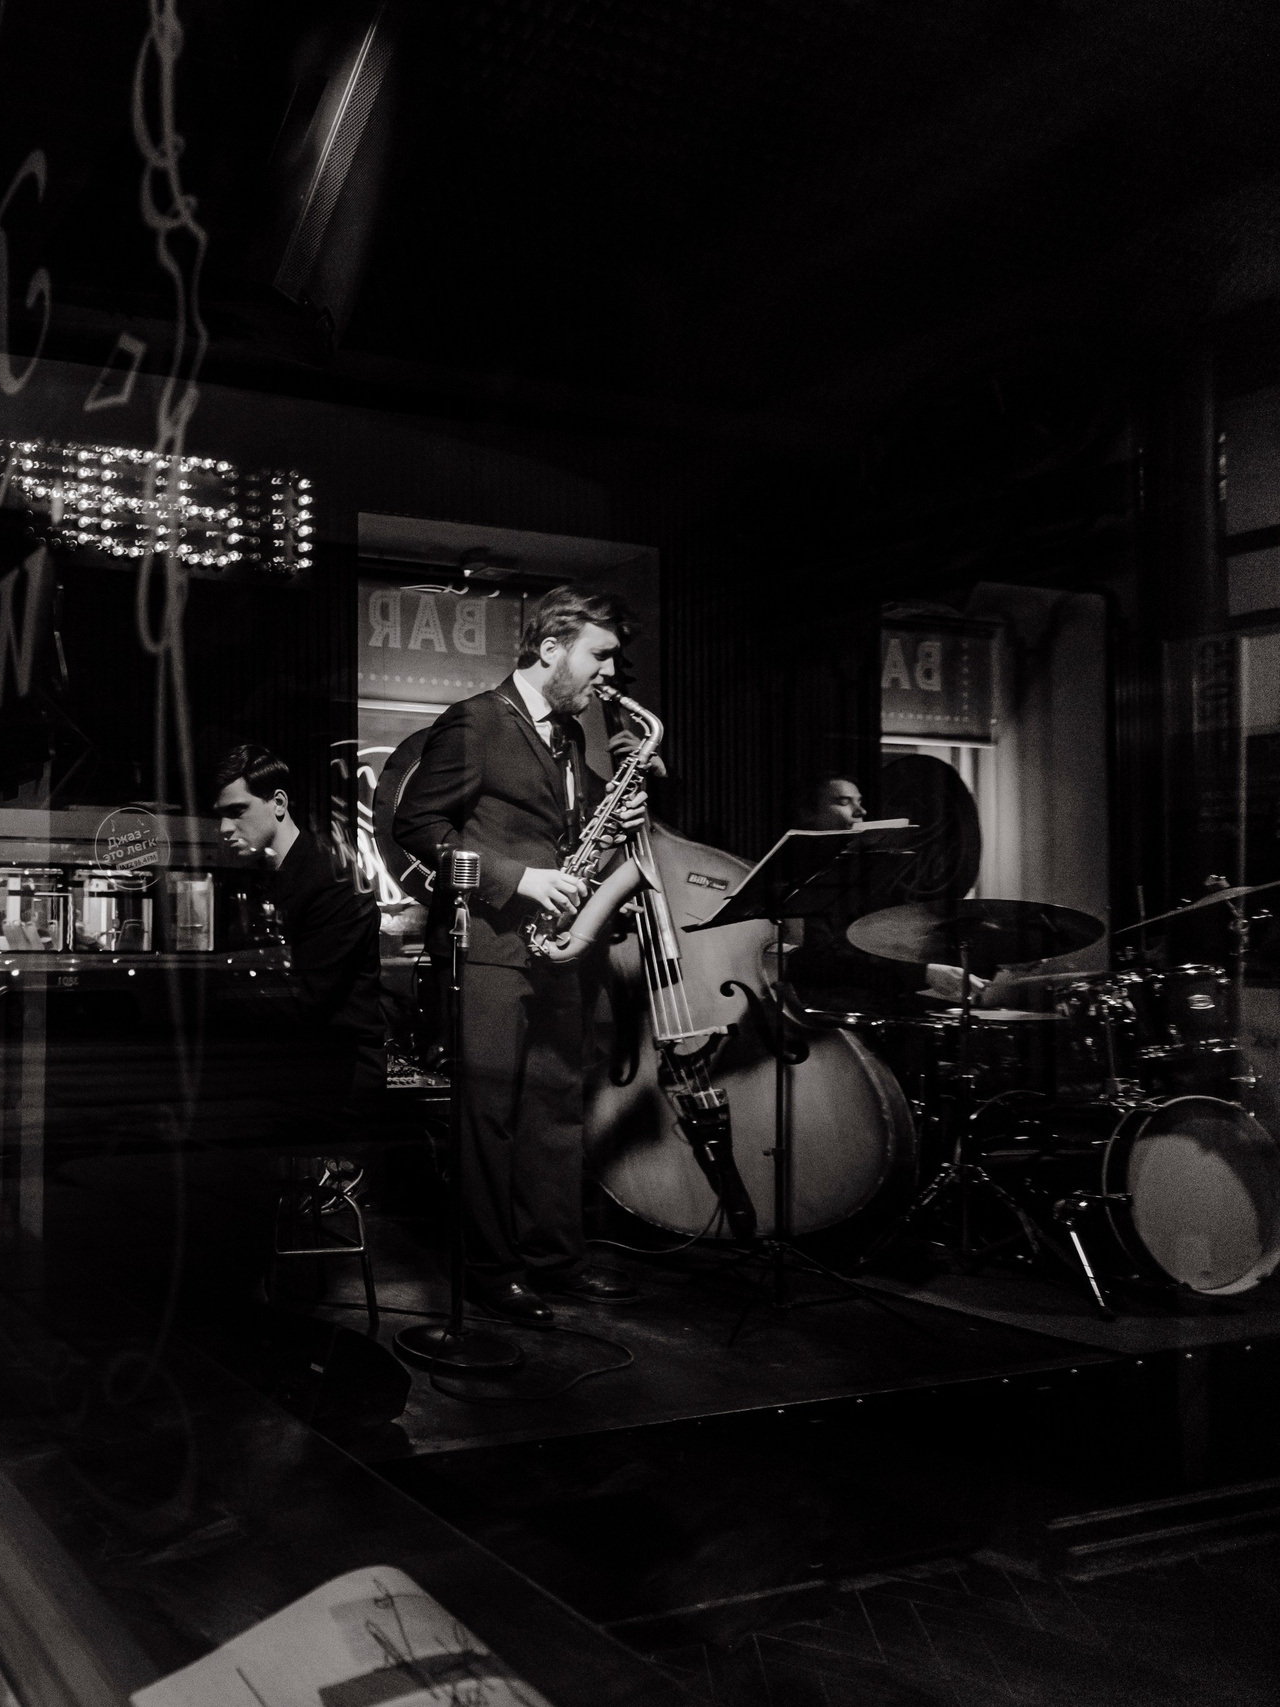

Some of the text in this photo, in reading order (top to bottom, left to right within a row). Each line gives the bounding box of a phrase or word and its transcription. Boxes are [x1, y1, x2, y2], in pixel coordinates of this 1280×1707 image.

[102, 836, 158, 863] это легк
[108, 830, 142, 850] Джаз
